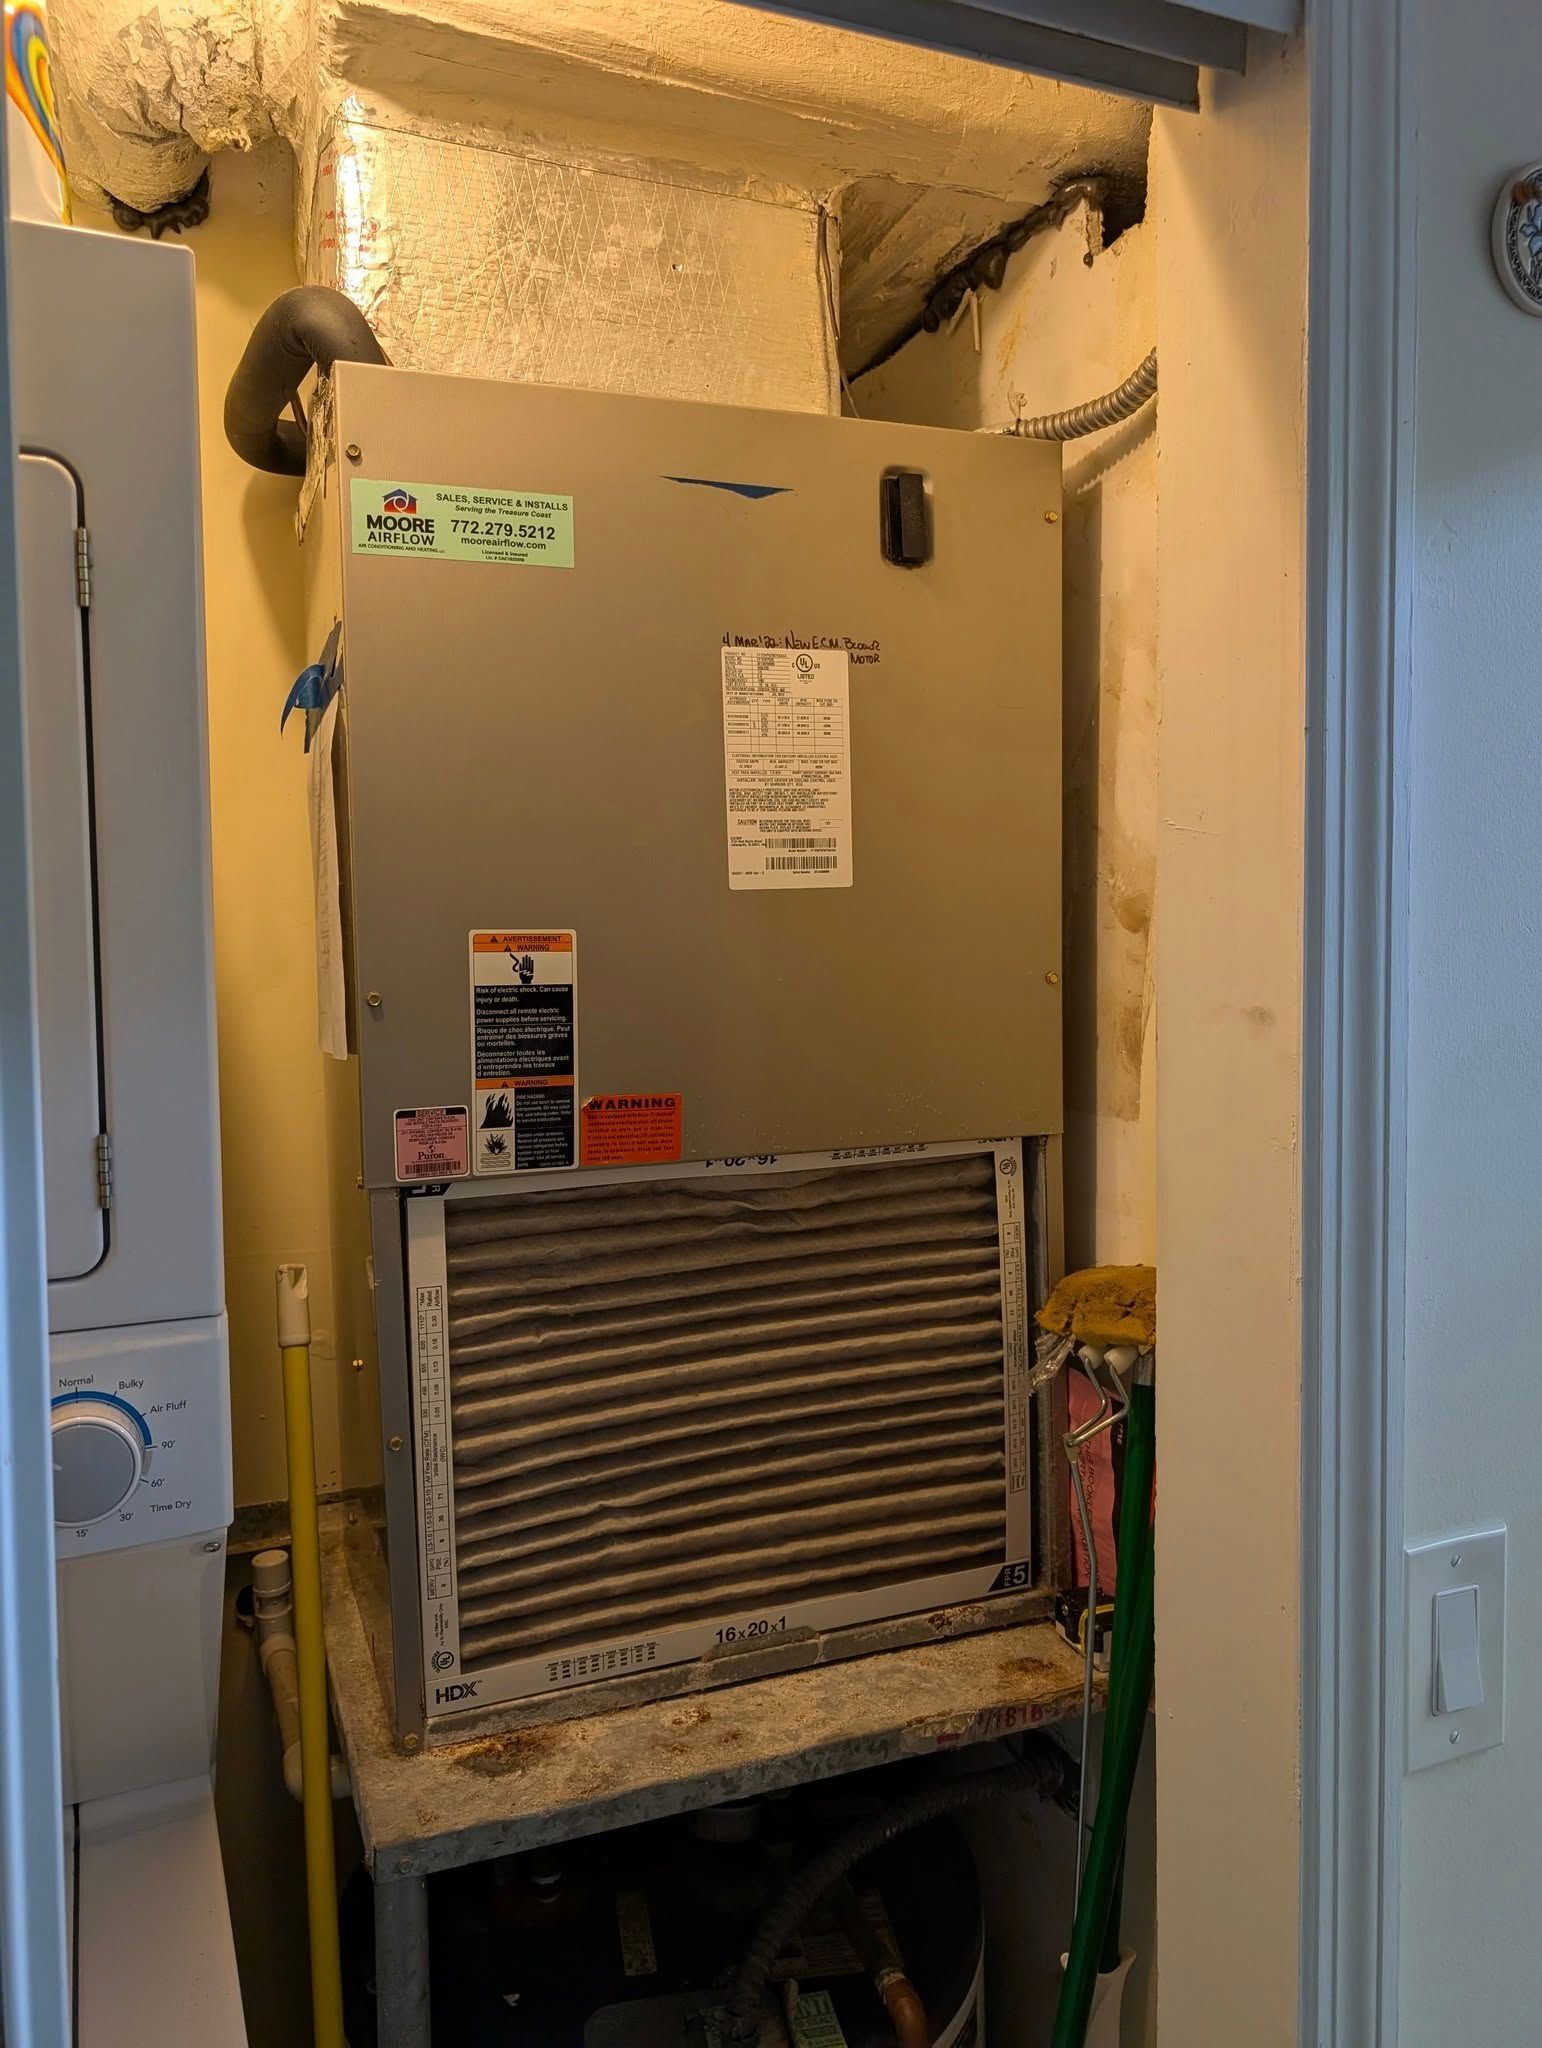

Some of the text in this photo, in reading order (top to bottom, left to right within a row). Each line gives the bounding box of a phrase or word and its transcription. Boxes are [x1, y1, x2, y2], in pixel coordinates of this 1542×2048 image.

[436, 493, 470, 504] SALES,
[472, 496, 514, 507] SERVICE
[524, 500, 568, 512] INSTALLS
[454, 504, 552, 519] Serving the Treasure Coast
[366, 514, 435, 533] MOORE
[450, 520, 556, 540] 772.279.5212
[368, 532, 435, 546] AIRFLOW
[460, 536, 547, 550] mooreairflow.com
[482, 549, 504, 557] Licensed
[850, 654, 880, 665] MOTOR
[514, 1079, 549, 1087] WARNING
[588, 1098, 676, 1111] WARNING
[416, 1109, 445, 1117] SERVICE
[418, 1152, 445, 1160] Puron
[59, 1374, 95, 1388] Normal
[118, 1379, 145, 1391] Bulky
[150, 1400, 187, 1415] Air Fluff
[150, 1500, 192, 1513] Time Dry
[1013, 1564, 1026, 1585] 5
